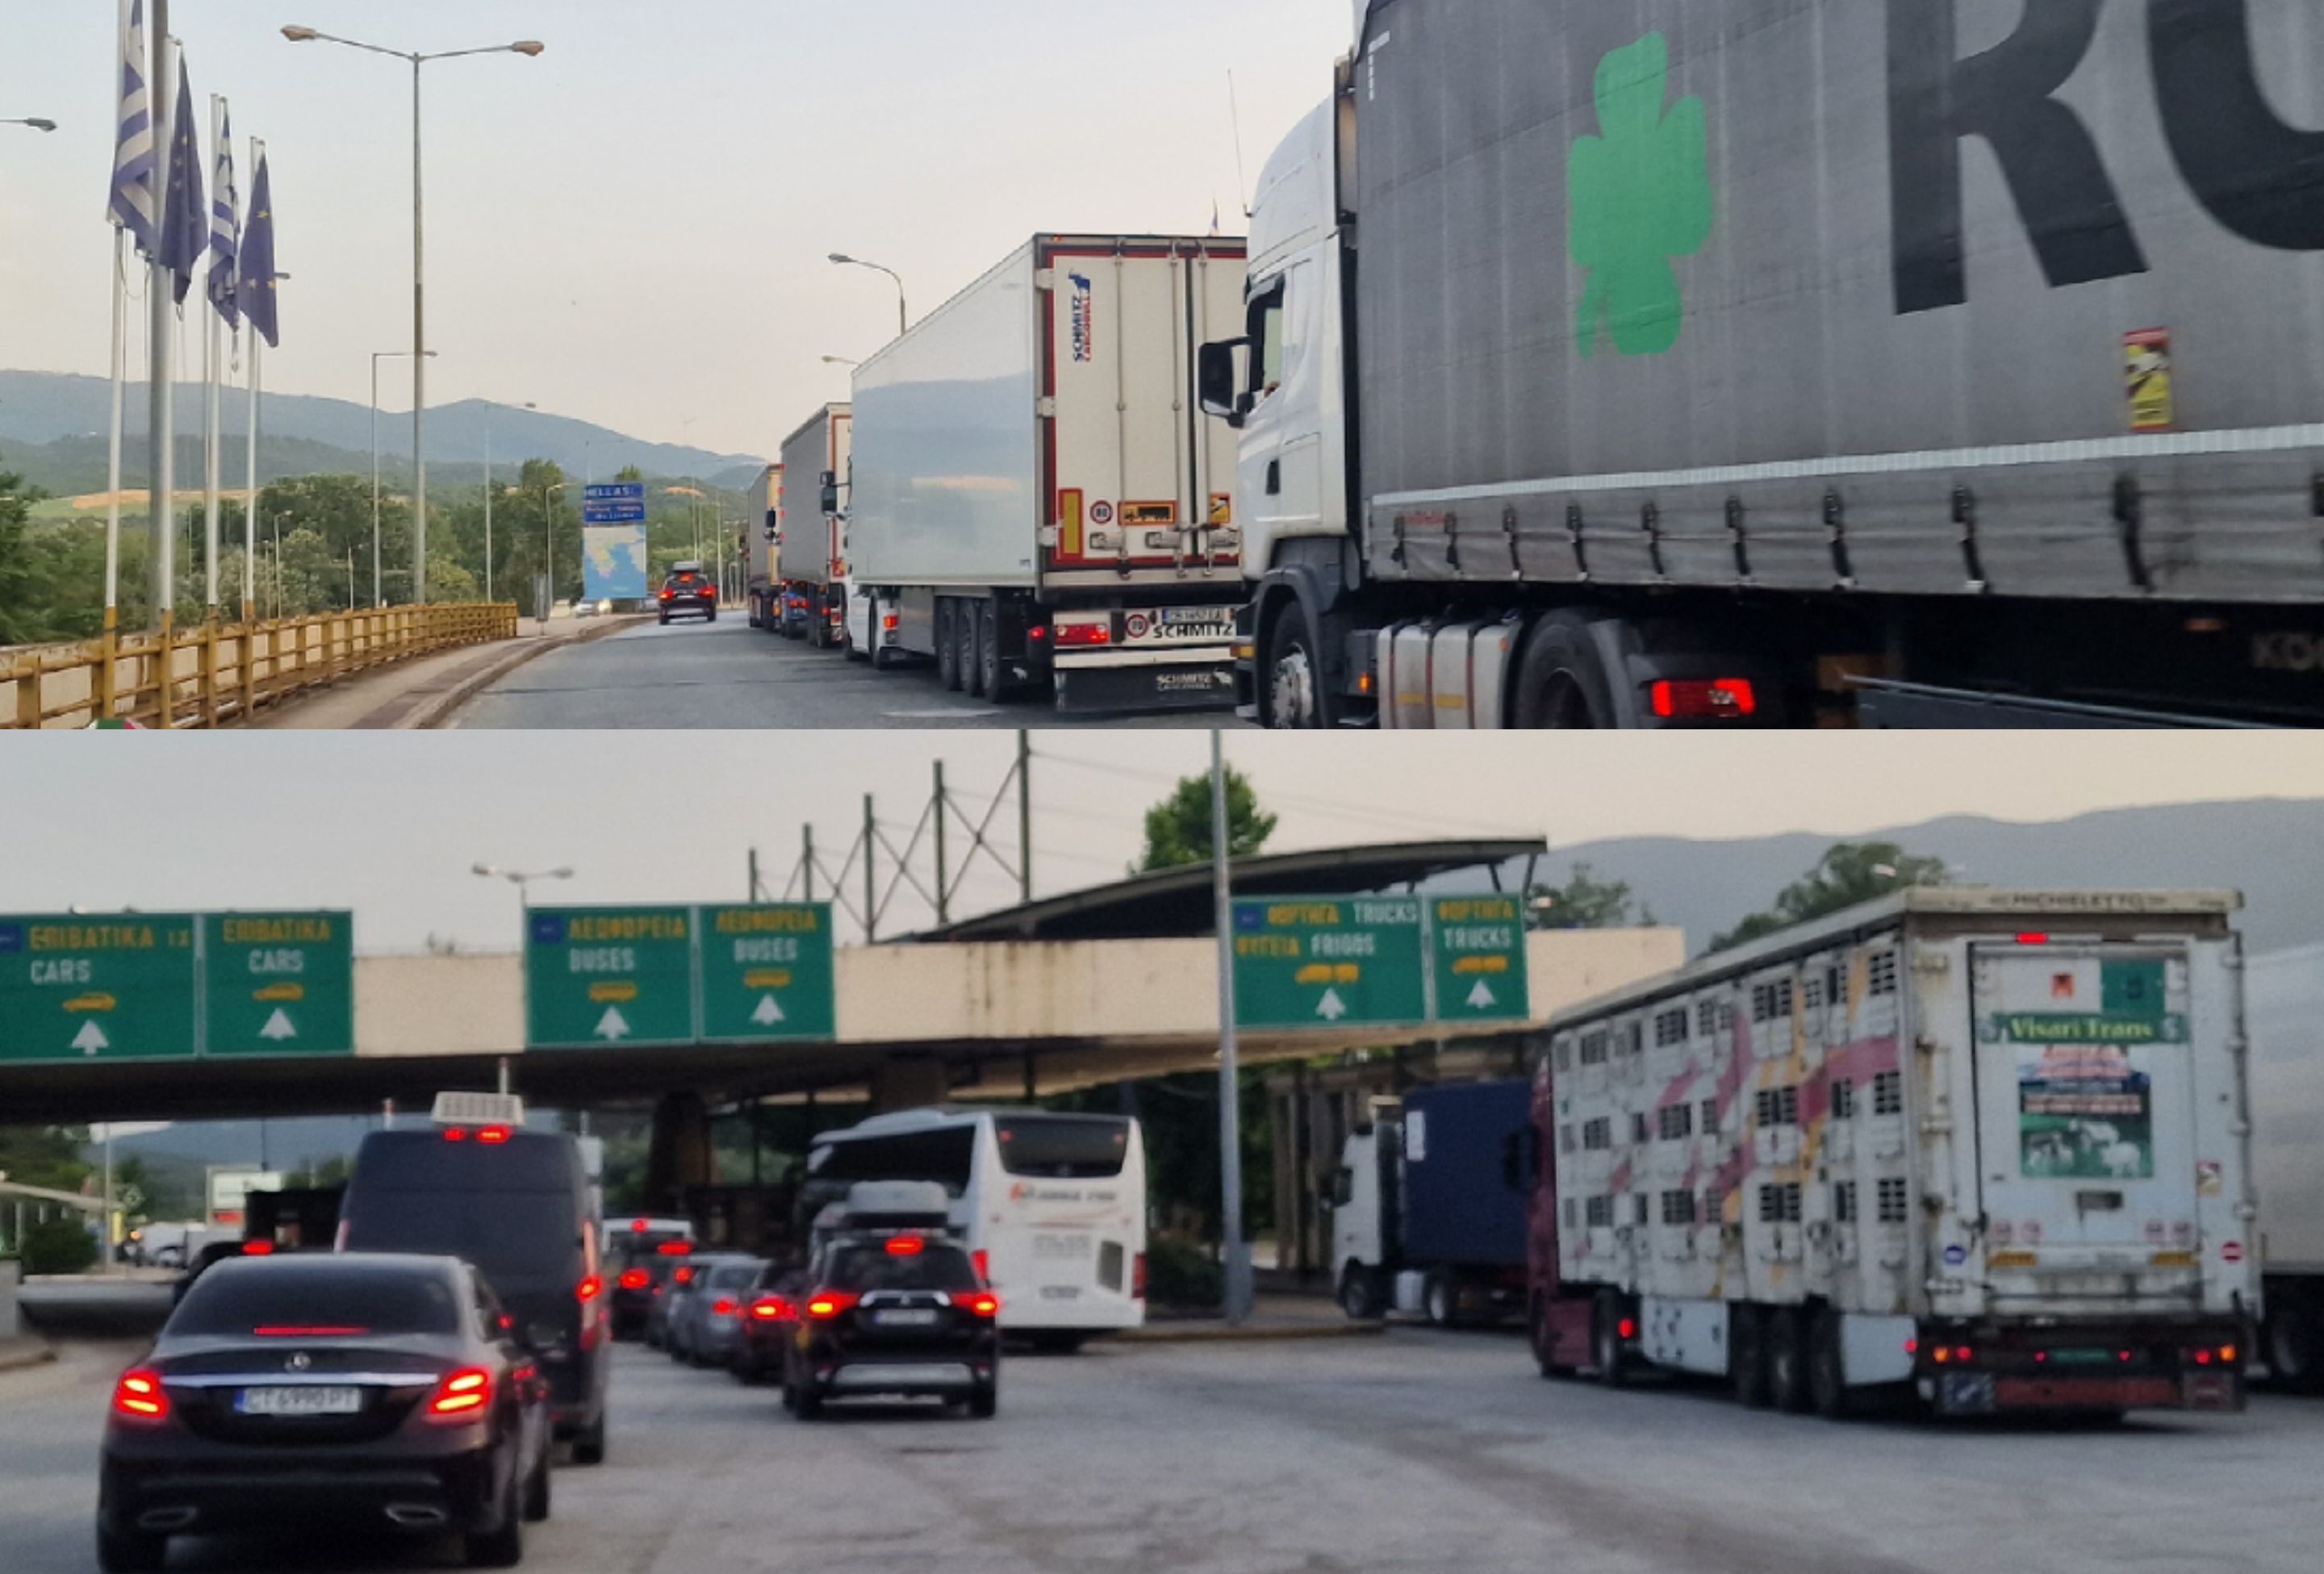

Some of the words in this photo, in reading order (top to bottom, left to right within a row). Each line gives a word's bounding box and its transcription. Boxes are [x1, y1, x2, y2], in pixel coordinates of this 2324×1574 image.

[1072, 294, 1082, 363] SCHMITZ
[1153, 624, 1233, 638] SCHMITZ
[1353, 902, 1418, 924] TRUCKS
[734, 938, 799, 962] BUSES
[1444, 928, 1512, 950] TRUCKS
[31, 960, 91, 984] CARS
[249, 949, 304, 973] CARS
[570, 947, 635, 973] BUSES
[2010, 1017, 2081, 1039] Visari
[2088, 1017, 2153, 1038] Trans
